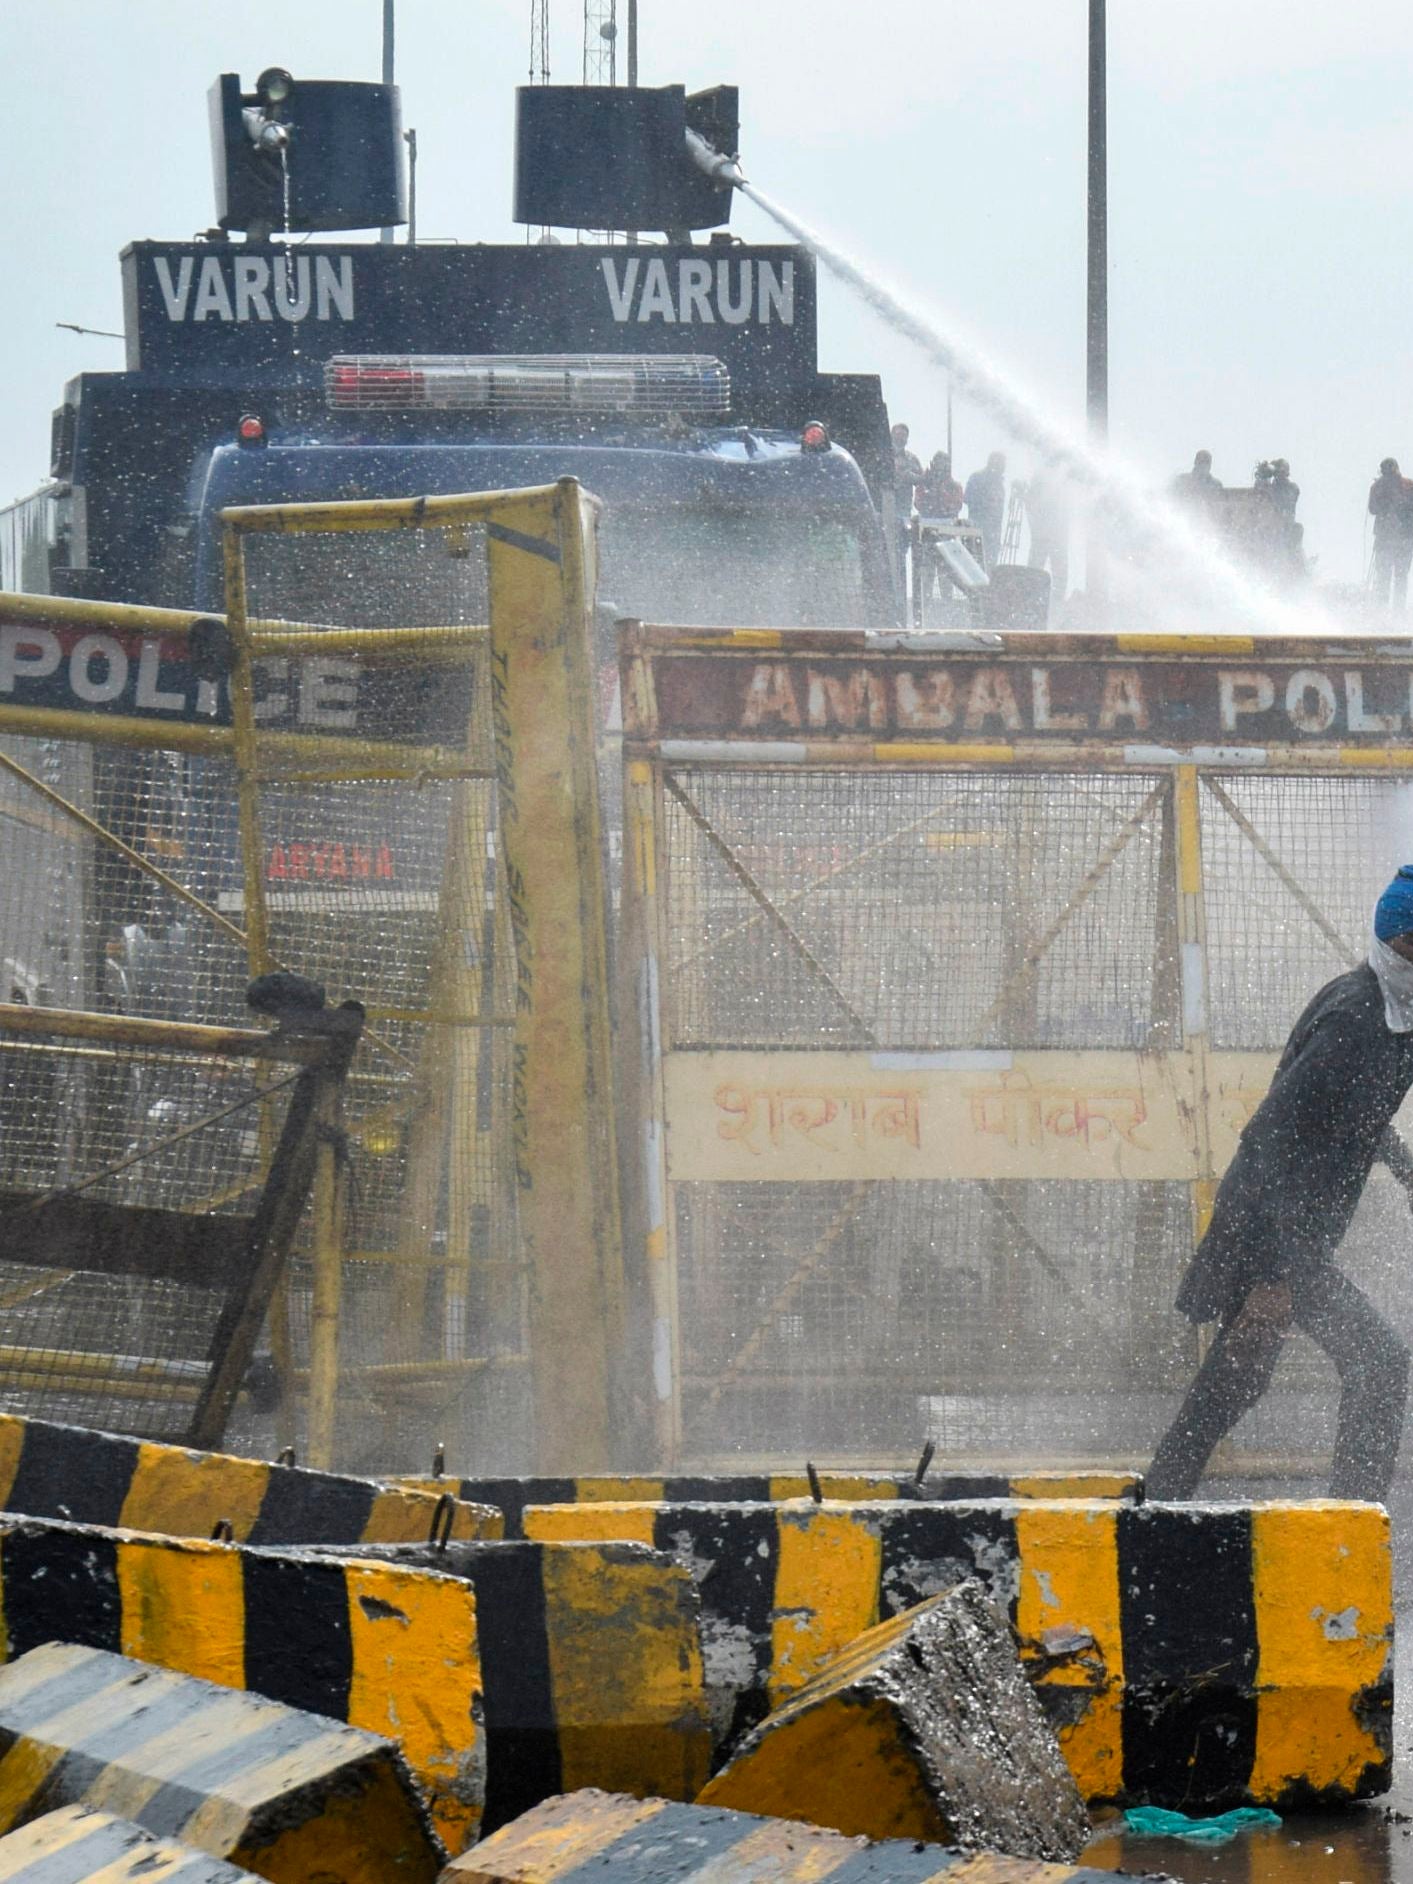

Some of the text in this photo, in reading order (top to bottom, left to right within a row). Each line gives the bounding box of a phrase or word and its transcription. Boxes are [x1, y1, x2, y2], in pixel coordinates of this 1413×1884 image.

[153, 256, 354, 322] VARUN
[600, 258, 794, 325] VARUN
[740, 662, 1150, 731] AMBALA
[266, 840, 394, 881] ARYANA
